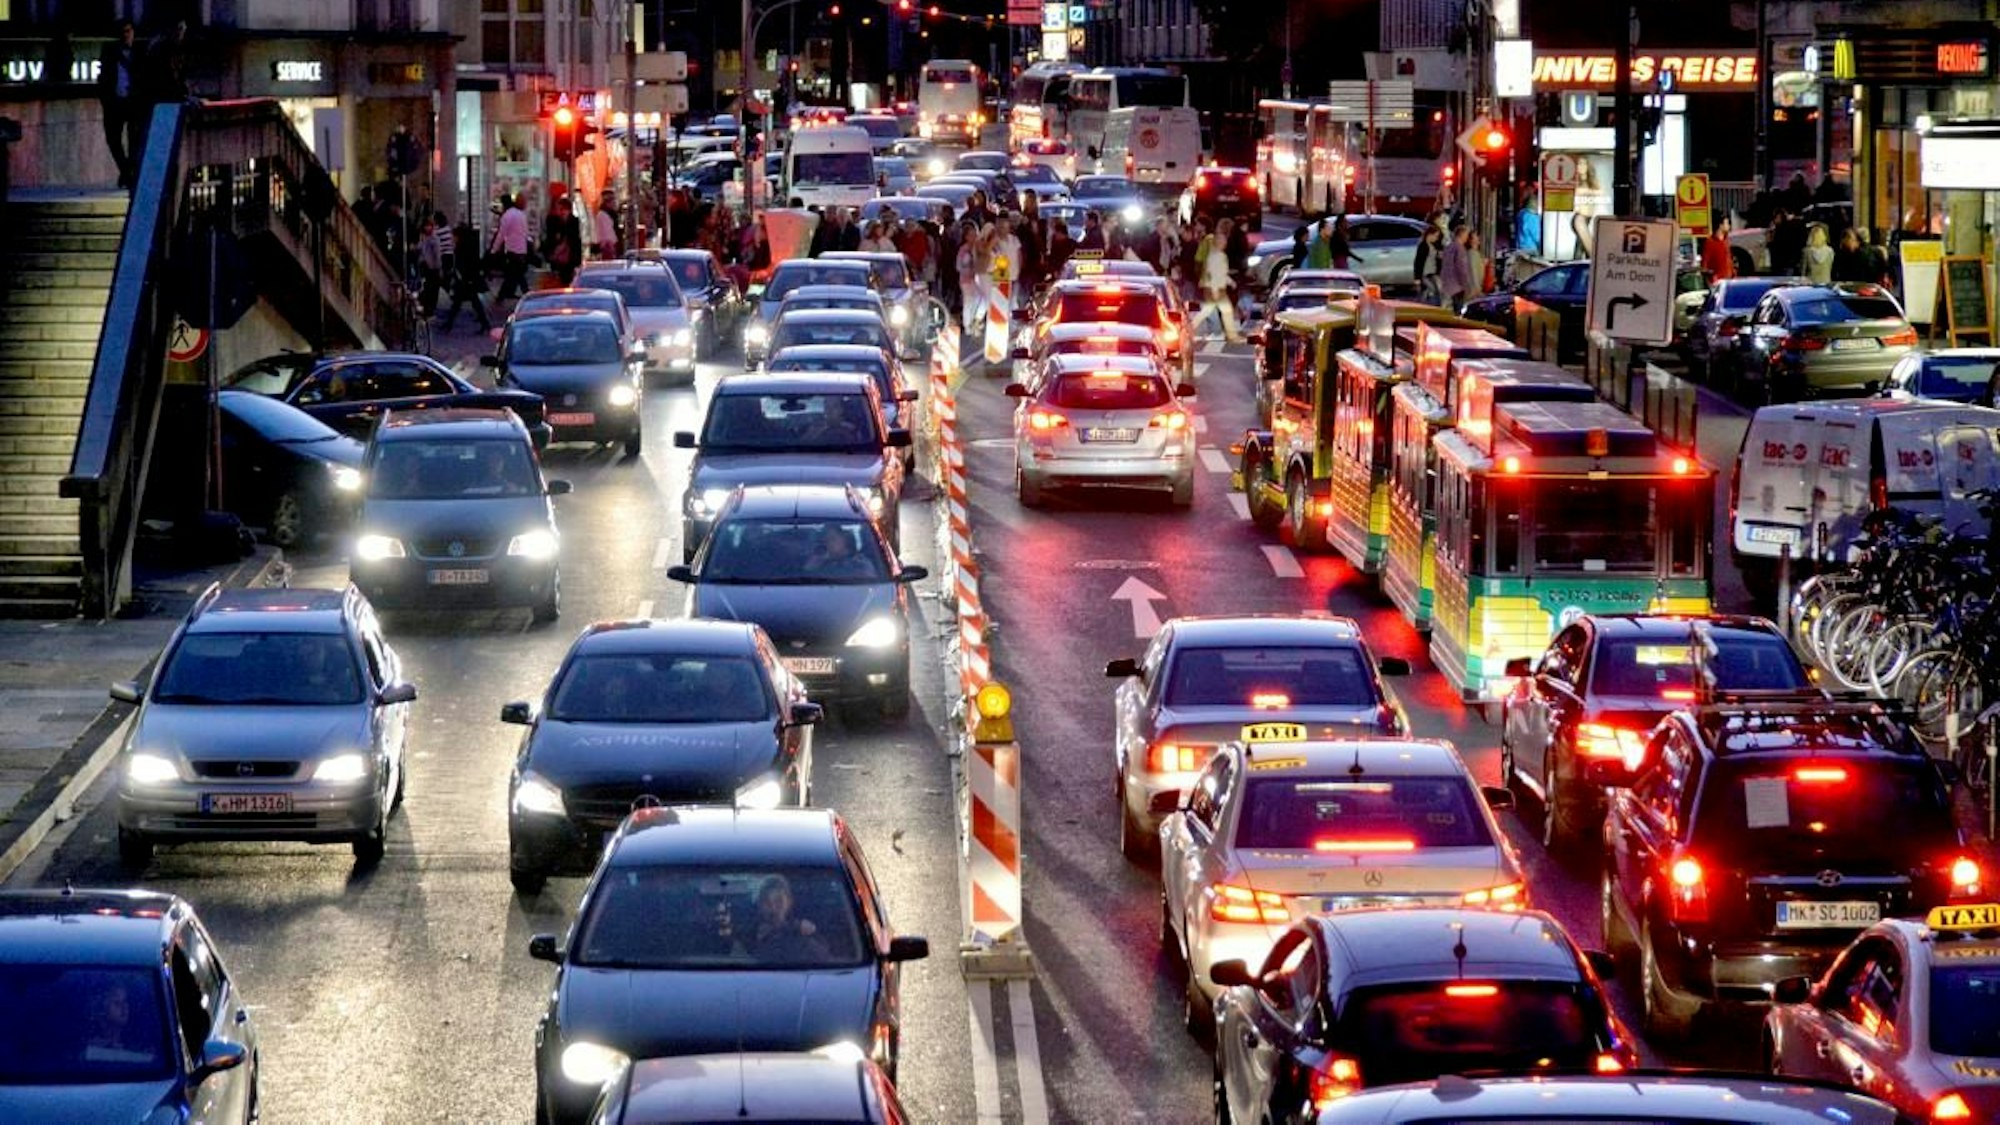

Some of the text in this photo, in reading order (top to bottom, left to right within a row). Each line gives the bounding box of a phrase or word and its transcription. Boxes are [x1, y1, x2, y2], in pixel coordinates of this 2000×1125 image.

[1937, 44, 1978, 71] PEKING
[277, 61, 322, 81] SERVICE
[1569, 95, 1592, 121] U
[1606, 252, 1660, 267] Parkhaus
[1606, 268, 1656, 282] Am Dom
[1251, 727, 1298, 739] TAXI
[251, 797, 285, 809] 1316
[1841, 905, 1878, 922] 1002
[1942, 908, 1995, 925] TAXI
